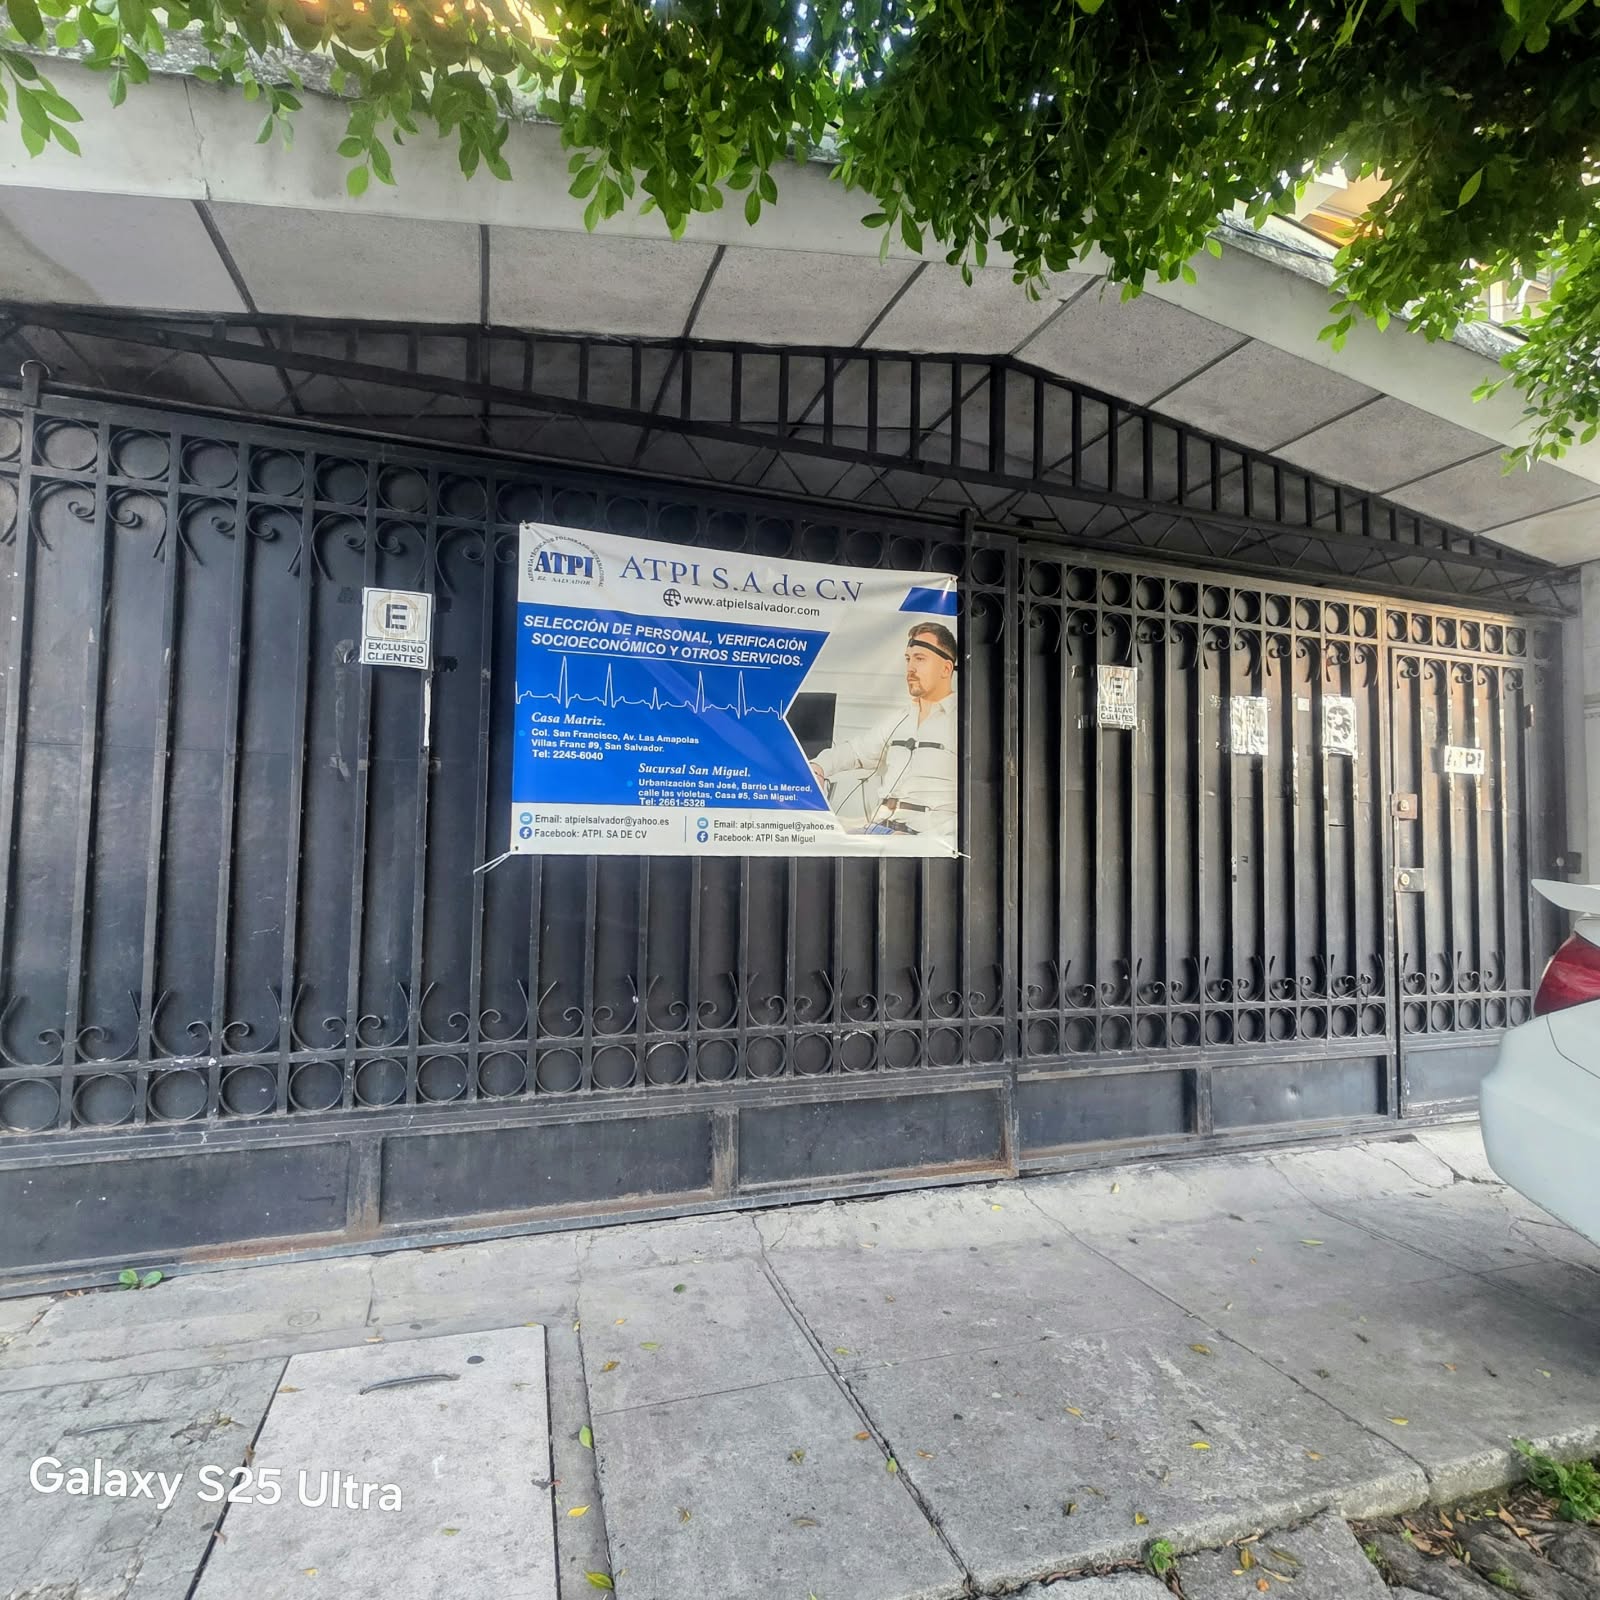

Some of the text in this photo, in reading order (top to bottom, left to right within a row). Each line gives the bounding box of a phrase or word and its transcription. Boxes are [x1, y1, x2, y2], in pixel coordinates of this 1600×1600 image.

[534, 551, 594, 579] ATPI
[619, 556, 701, 586] ATPI
[772, 574, 807, 598] de
[815, 578, 864, 602] C.V
[683, 595, 820, 616] www.atpielsalvador.com
[386, 603, 407, 630] E
[523, 614, 807, 651] SELECCIÓN DE PERSONAL, VERIFICACIÓN
[368, 642, 424, 654] EXCLUSIVO
[531, 633, 804, 667] SOCIOECONÓMICO Y OTROS SERVICIOS.
[367, 652, 424, 664] CLIENTES
[531, 712, 606, 726] Casa Matriz.
[531, 728, 700, 745] Col. San Francisco, Av. Las Amapolas
[531, 739, 558, 748] Villas
[559, 741, 586, 749] Franc
[605, 742, 622, 751] San
[624, 743, 664, 752] Salvador.
[532, 750, 604, 760] Tel: 2245-6040
[638, 763, 751, 779] Sucursal San Miguel.
[638, 779, 813, 793] Urbanización San José, Barrio La Merced,
[638, 789, 659, 797] calle
[661, 790, 674, 798] las
[676, 791, 713, 799] violetas,
[715, 791, 736, 799] Casa
[770, 793, 798, 802] Miguel.
[639, 798, 706, 807] Tel: 2661-5328
[535, 815, 670, 827] Email: atpielsalvador@yahoo.es
[714, 820, 835, 832] Email: atpi.sanmiguel@yahoo.es
[534, 829, 580, 838] Facebook:
[606, 830, 619, 839] SA
[620, 830, 633, 839] DE
[634, 830, 648, 839] CV
[714, 834, 816, 845] Facebook: ATPI San Miguel
